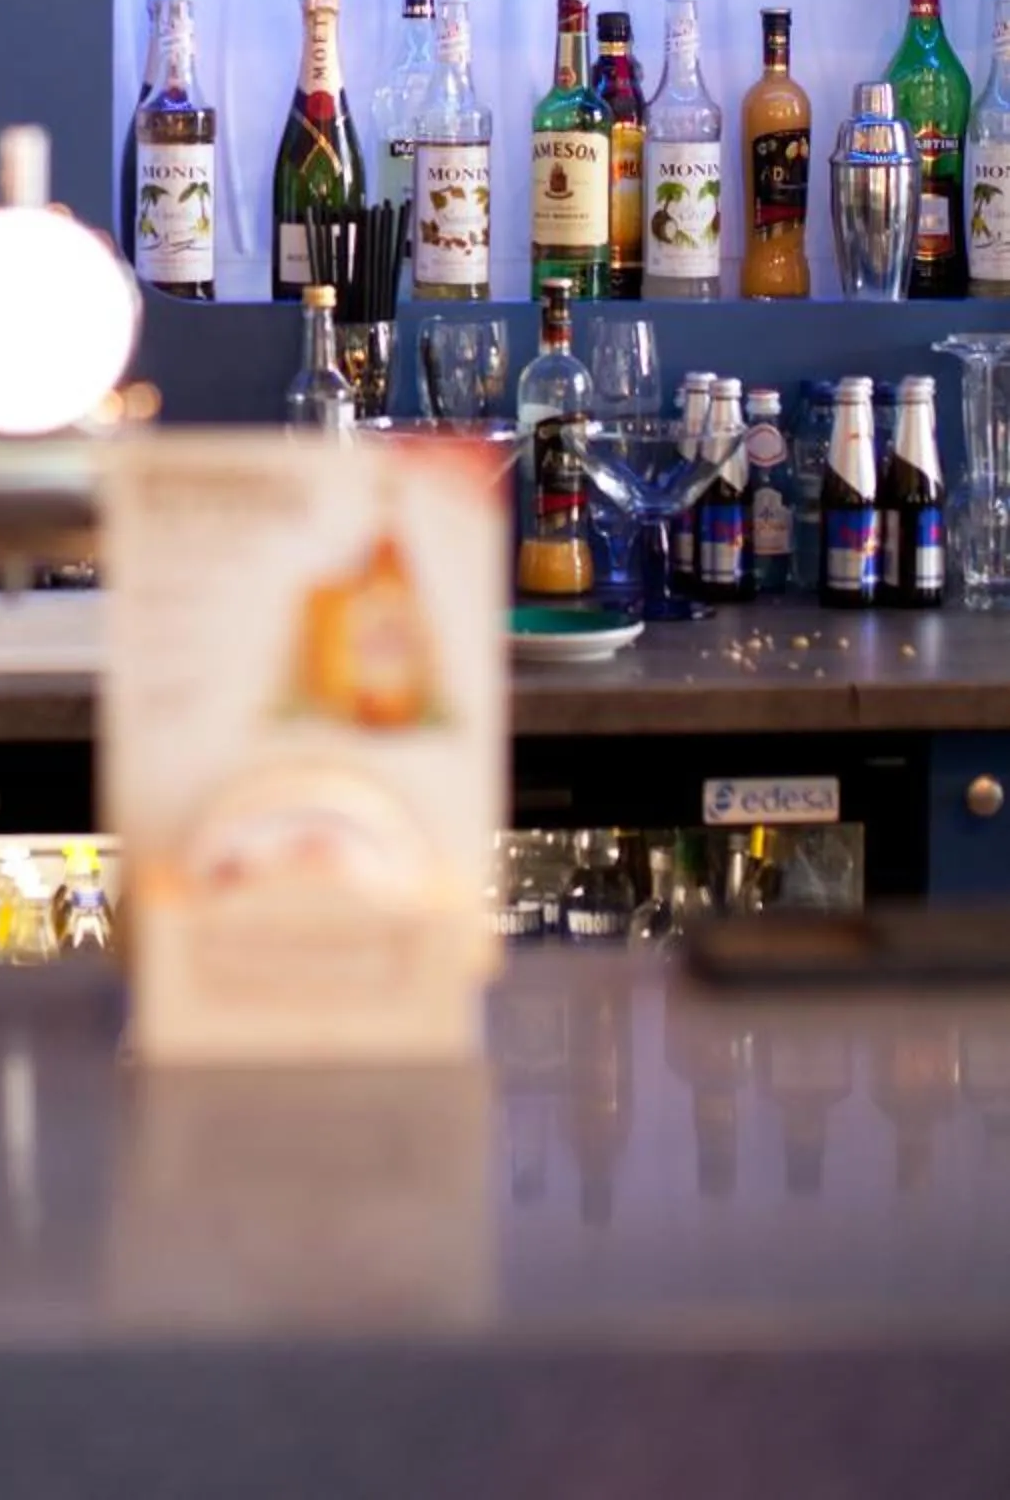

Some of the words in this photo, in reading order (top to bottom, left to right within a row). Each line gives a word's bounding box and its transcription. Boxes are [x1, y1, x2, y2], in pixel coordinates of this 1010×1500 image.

[914, 137, 959, 150] ARTINI
[532, 141, 597, 163] AMESON
[143, 165, 207, 179] MONIN
